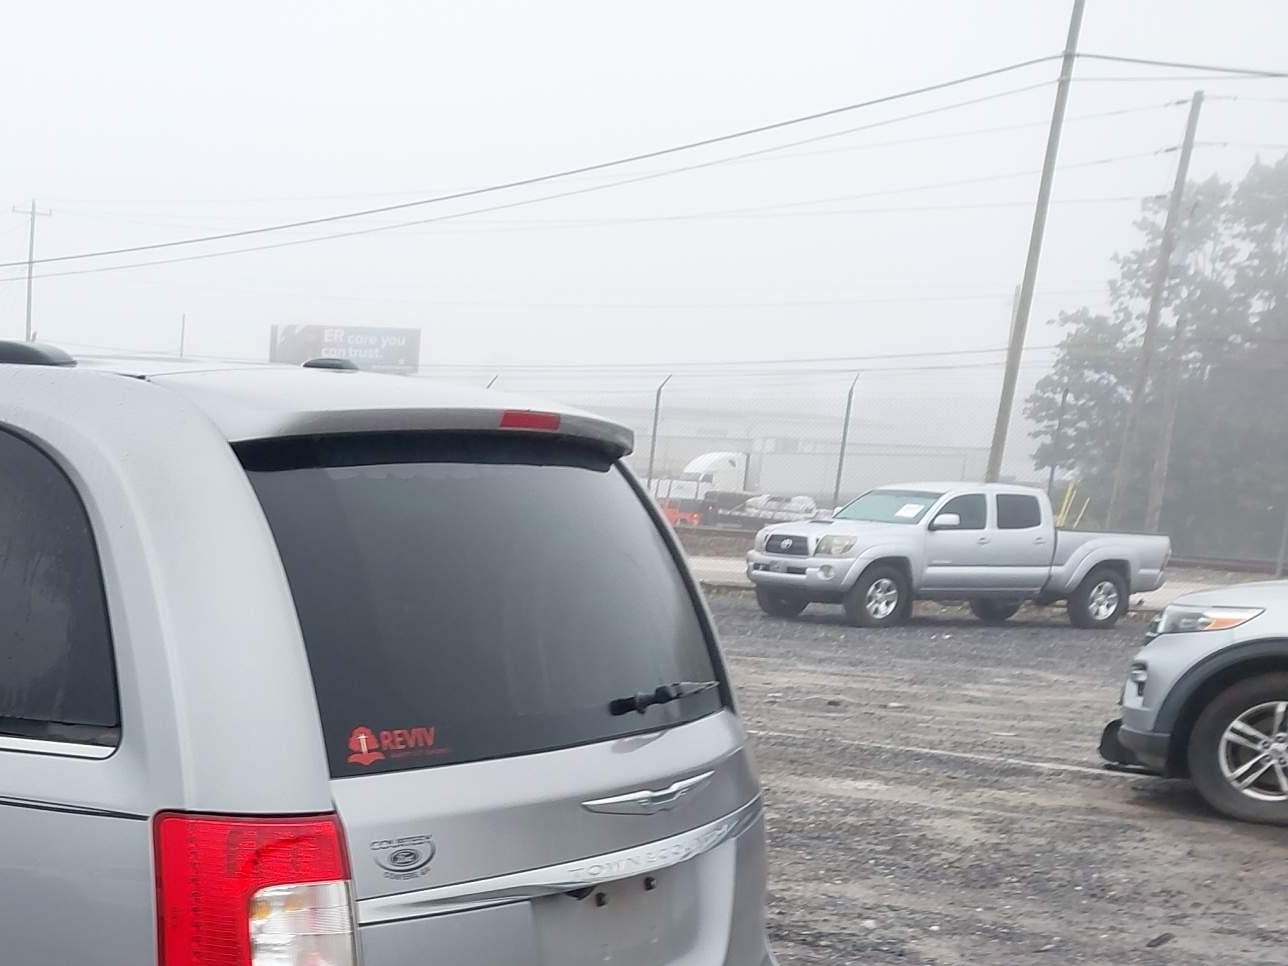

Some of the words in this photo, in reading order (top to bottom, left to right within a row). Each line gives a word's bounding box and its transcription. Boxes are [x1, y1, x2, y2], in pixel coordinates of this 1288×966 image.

[347, 334, 377, 345] care
[380, 335, 406, 349] you
[320, 347, 345, 358] can
